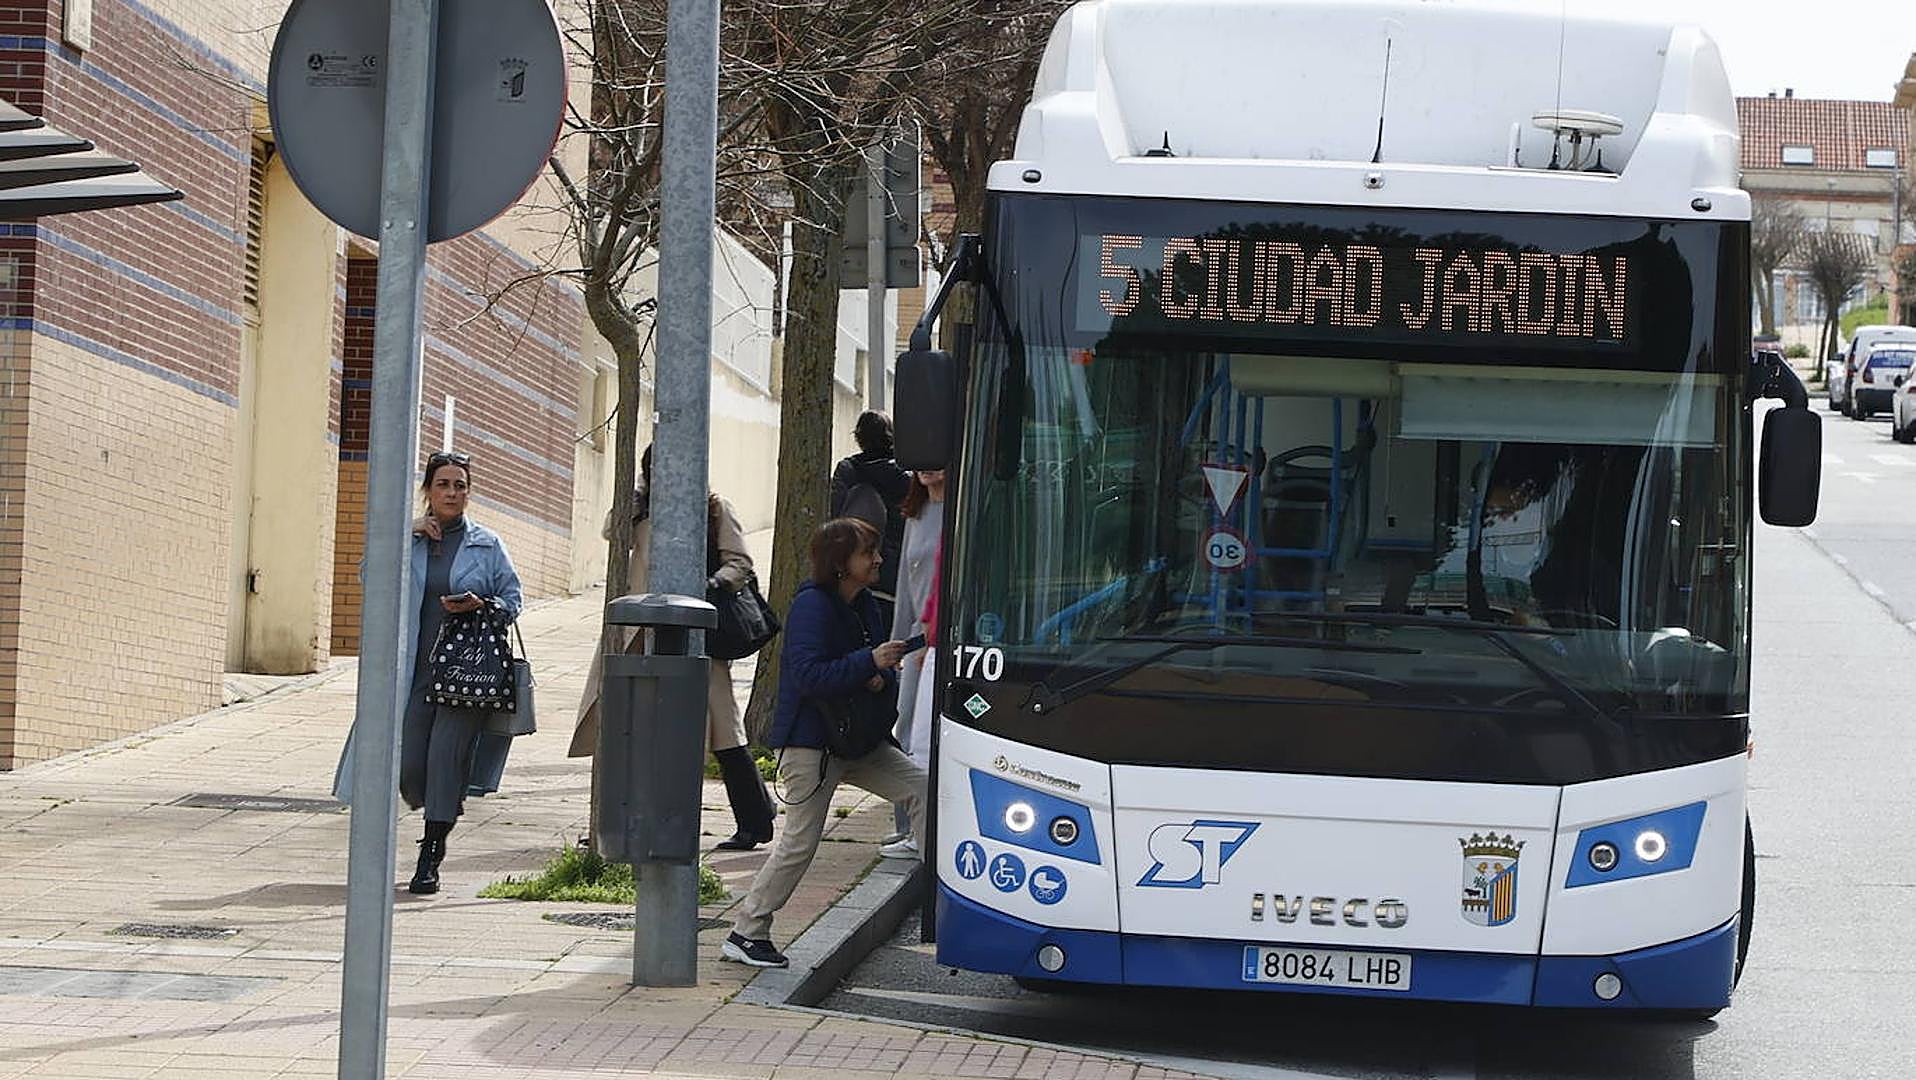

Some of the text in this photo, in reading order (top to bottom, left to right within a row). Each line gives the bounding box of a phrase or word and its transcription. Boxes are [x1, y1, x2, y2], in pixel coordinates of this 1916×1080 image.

[1099, 235, 1627, 339] 5 CIUDAD JARDIN
[953, 644, 1004, 682] 170
[1136, 820, 1261, 888] ST
[1250, 892, 1409, 929] IVECO
[1264, 952, 1335, 982] 8084
[1347, 956, 1401, 985] LHB
